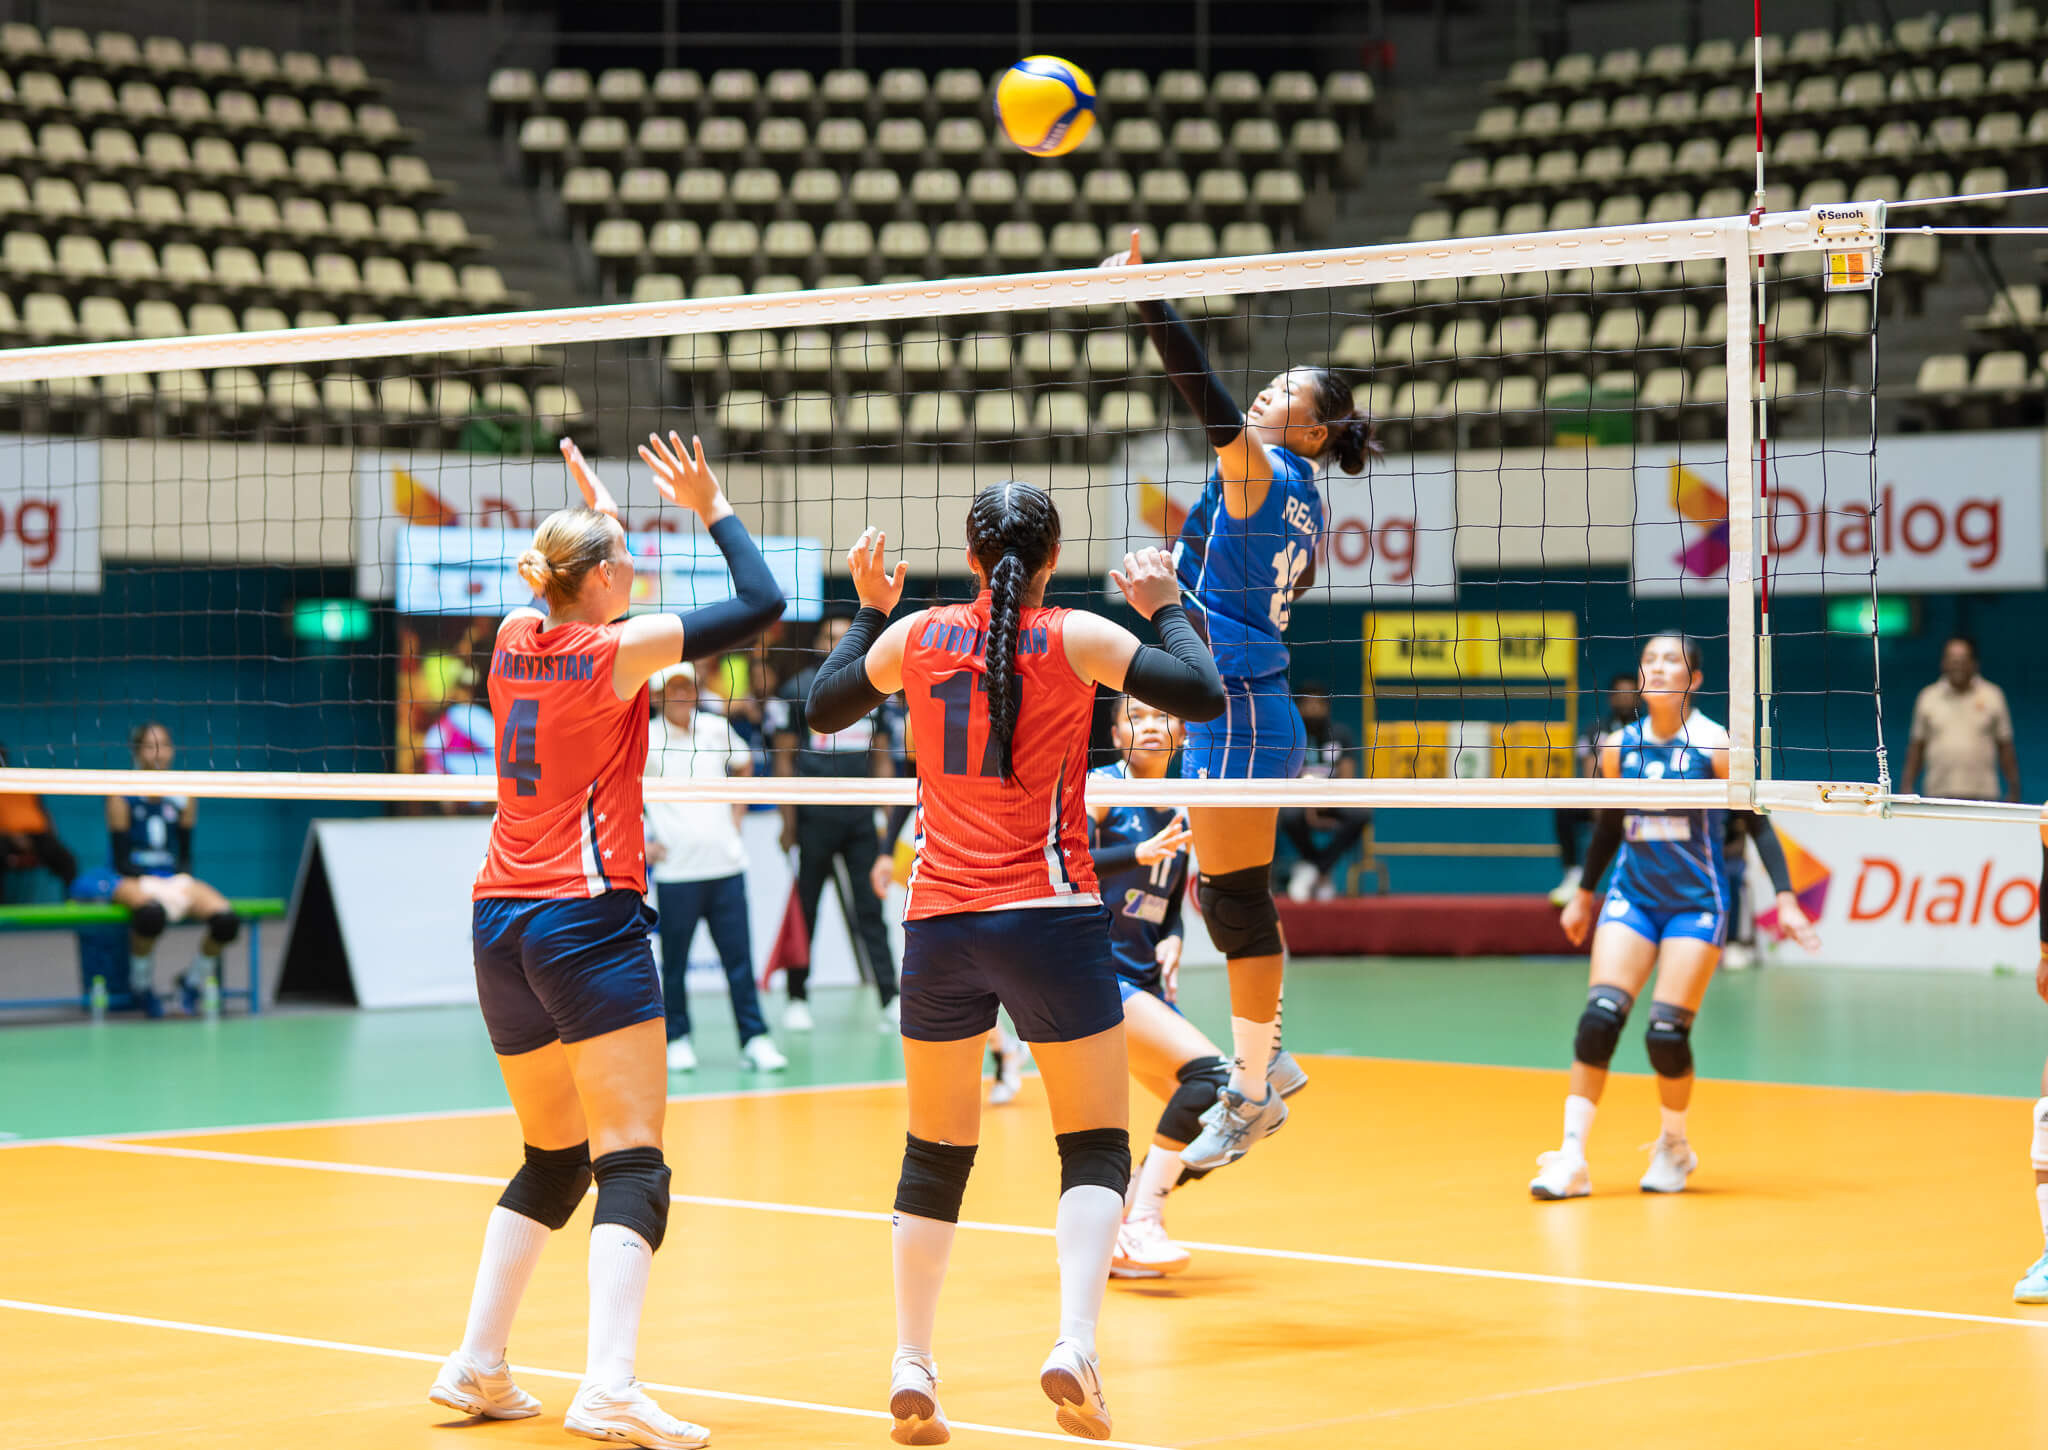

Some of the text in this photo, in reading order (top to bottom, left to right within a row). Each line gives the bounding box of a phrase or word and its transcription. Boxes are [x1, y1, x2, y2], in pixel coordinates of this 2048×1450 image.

[1827, 209, 1864, 220] Senoh
[1764, 483, 2003, 573] Dialog
[920, 622, 1048, 657] KYRGYAN
[491, 649, 594, 681] YRGYZSTAN
[500, 699, 542, 797] 4
